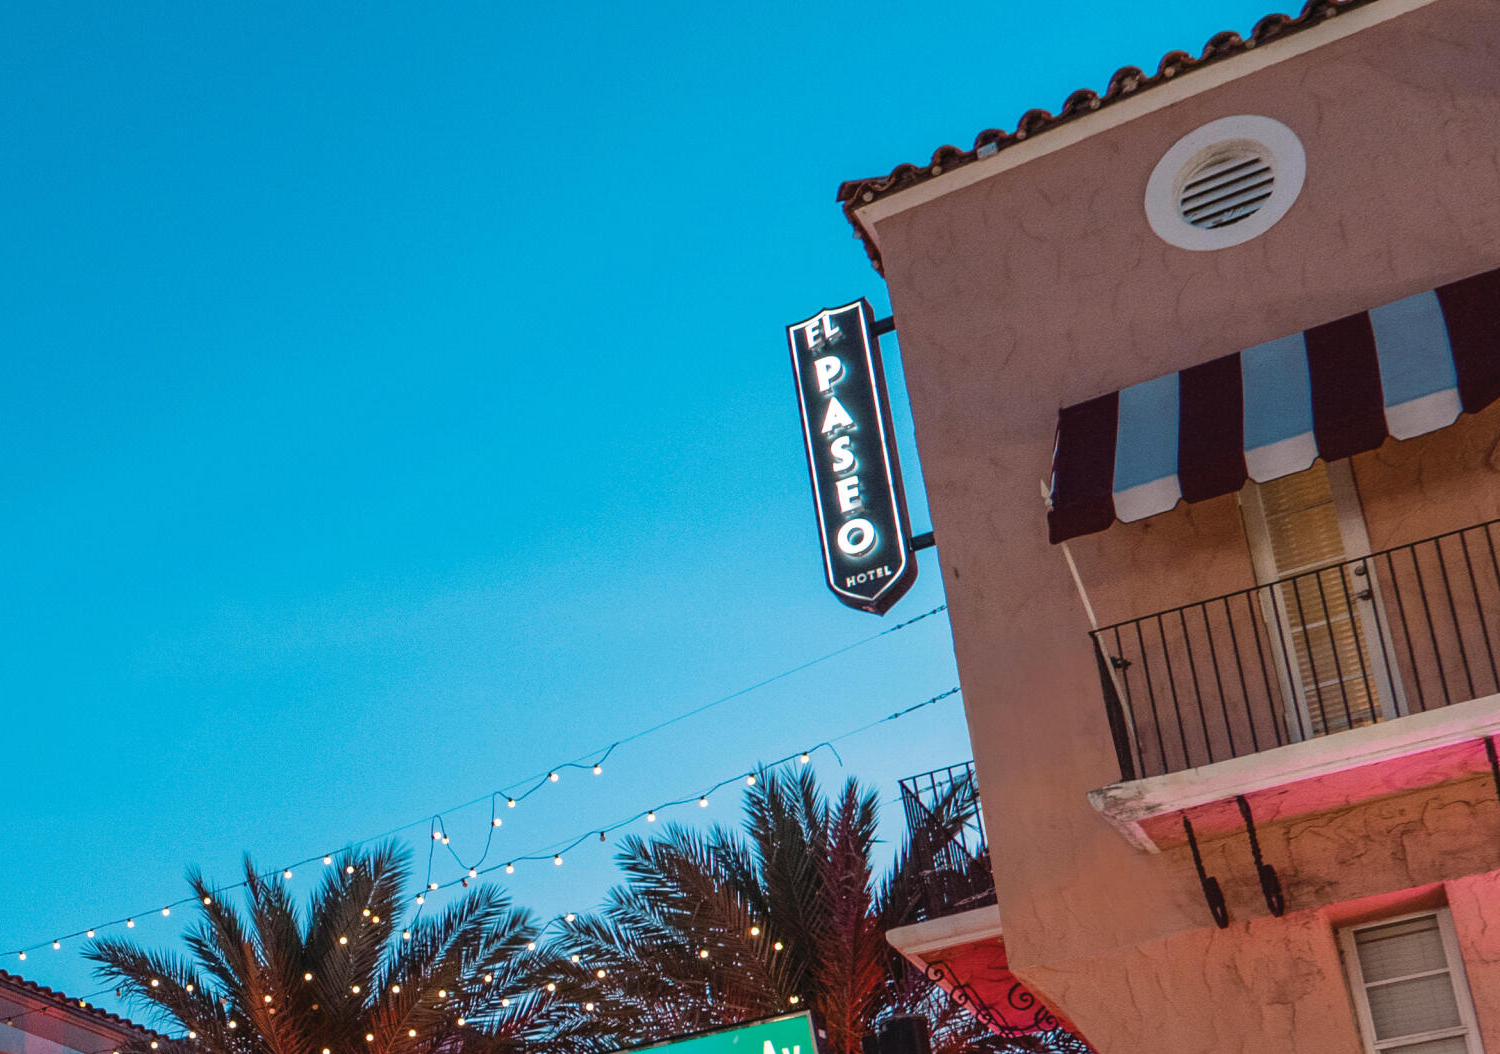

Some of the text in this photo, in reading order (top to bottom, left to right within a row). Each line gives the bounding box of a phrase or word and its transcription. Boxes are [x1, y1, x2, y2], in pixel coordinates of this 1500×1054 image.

[805, 316, 840, 349] EL
[814, 355, 876, 554] PASEO
[846, 565, 891, 588] HOTEL
